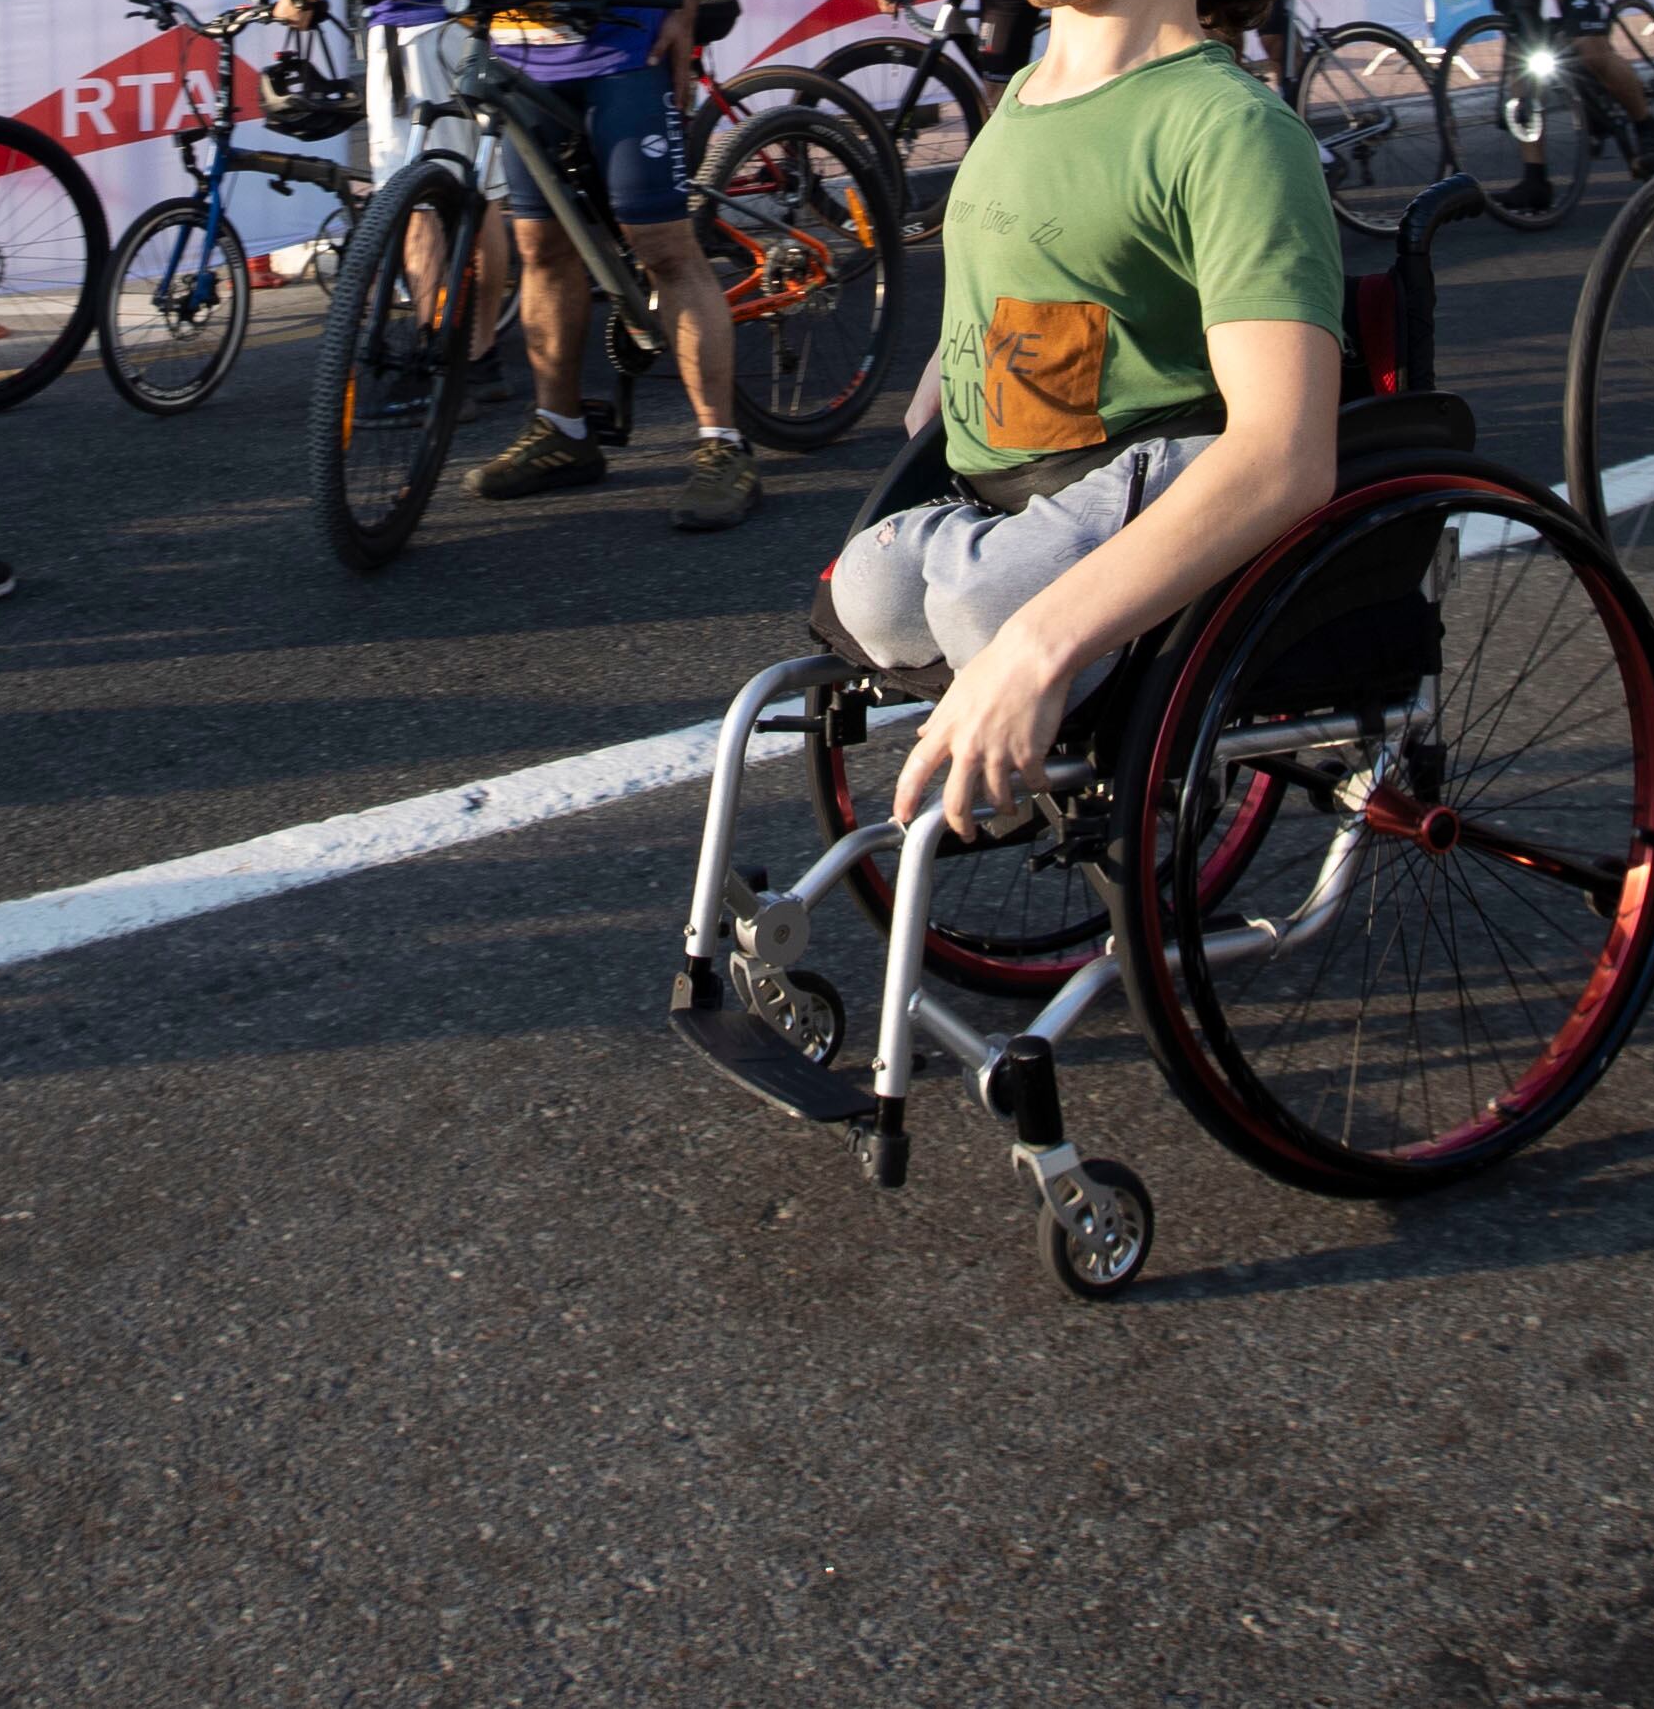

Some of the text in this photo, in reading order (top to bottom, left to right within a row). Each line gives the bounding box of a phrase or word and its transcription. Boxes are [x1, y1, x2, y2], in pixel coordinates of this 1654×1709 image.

[61, 69, 217, 138] RTA
[980, 200, 1020, 235] time
[1029, 217, 1064, 247] to
[942, 320, 1042, 375] HAVE
